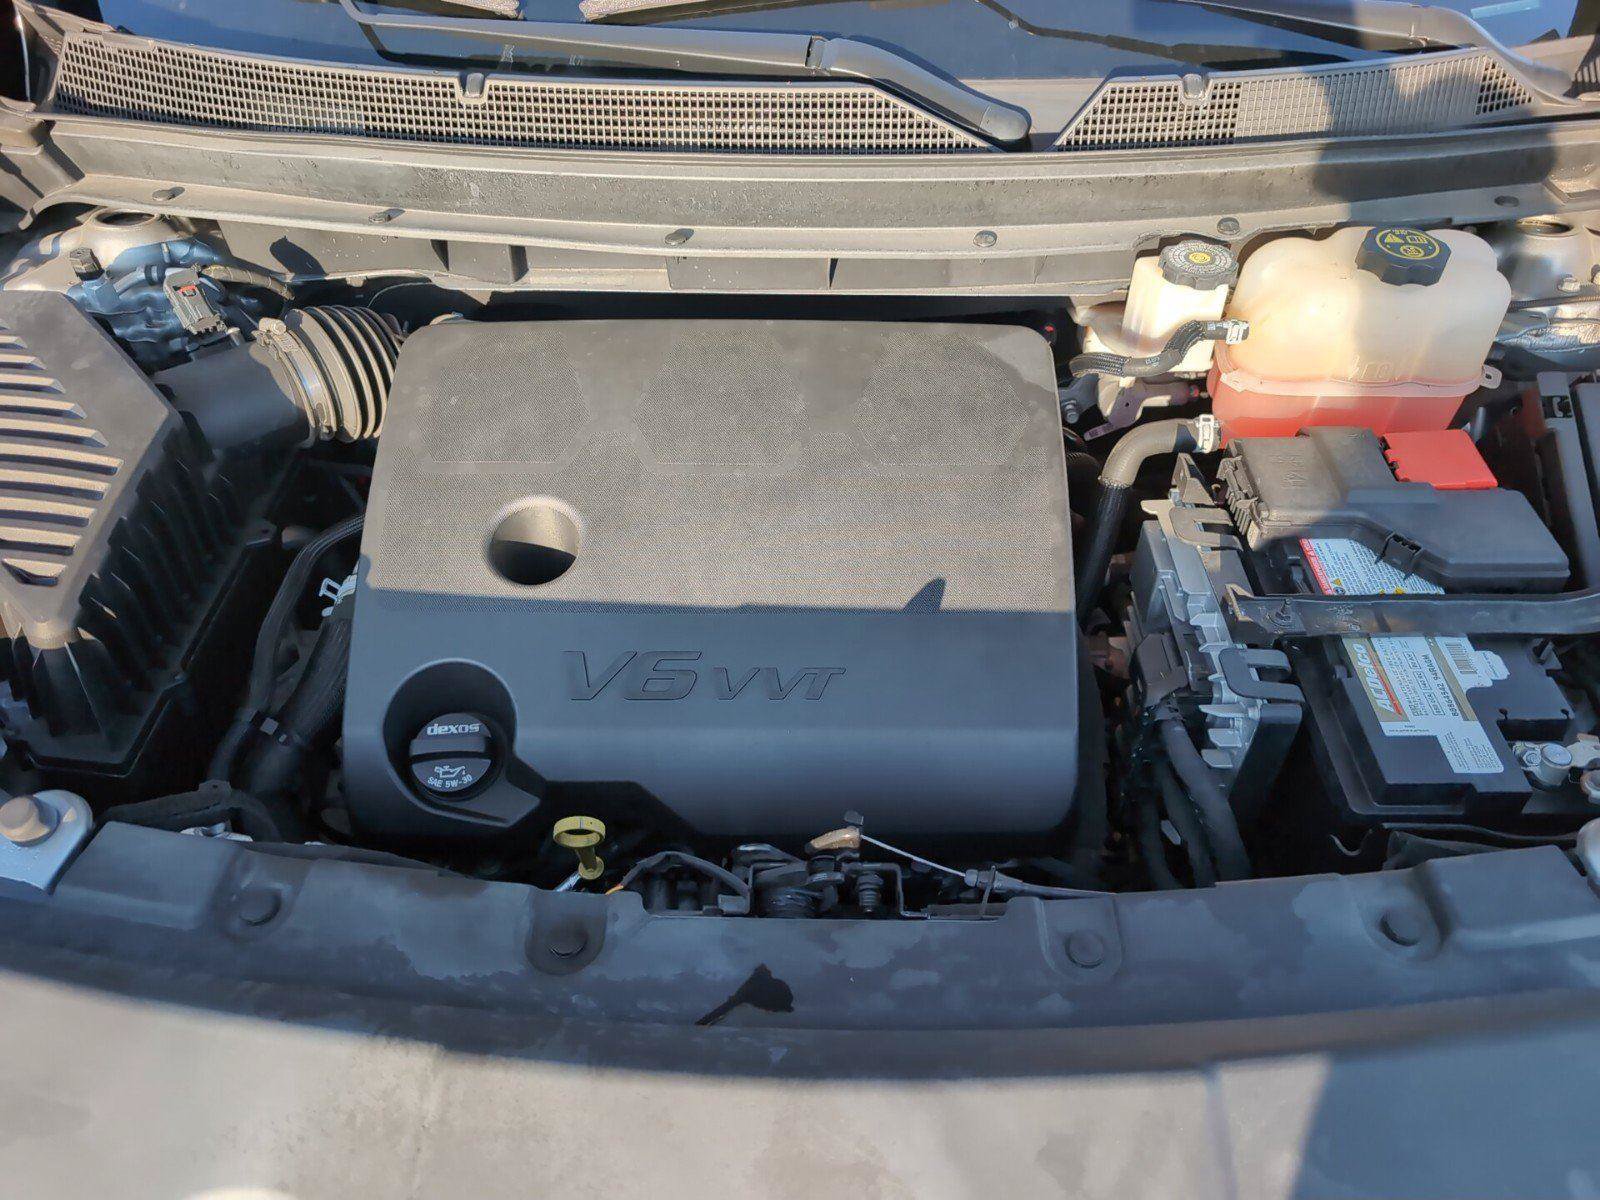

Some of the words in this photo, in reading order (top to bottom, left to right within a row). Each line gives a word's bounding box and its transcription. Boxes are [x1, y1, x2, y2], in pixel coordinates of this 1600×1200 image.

[561, 650, 703, 701] V6
[712, 667, 847, 701] VVT
[1352, 643, 1395, 712] ACDelco
[426, 723, 481, 736] dexos
[427, 776, 444, 788] SAE
[445, 773, 473, 788] 5W-30
